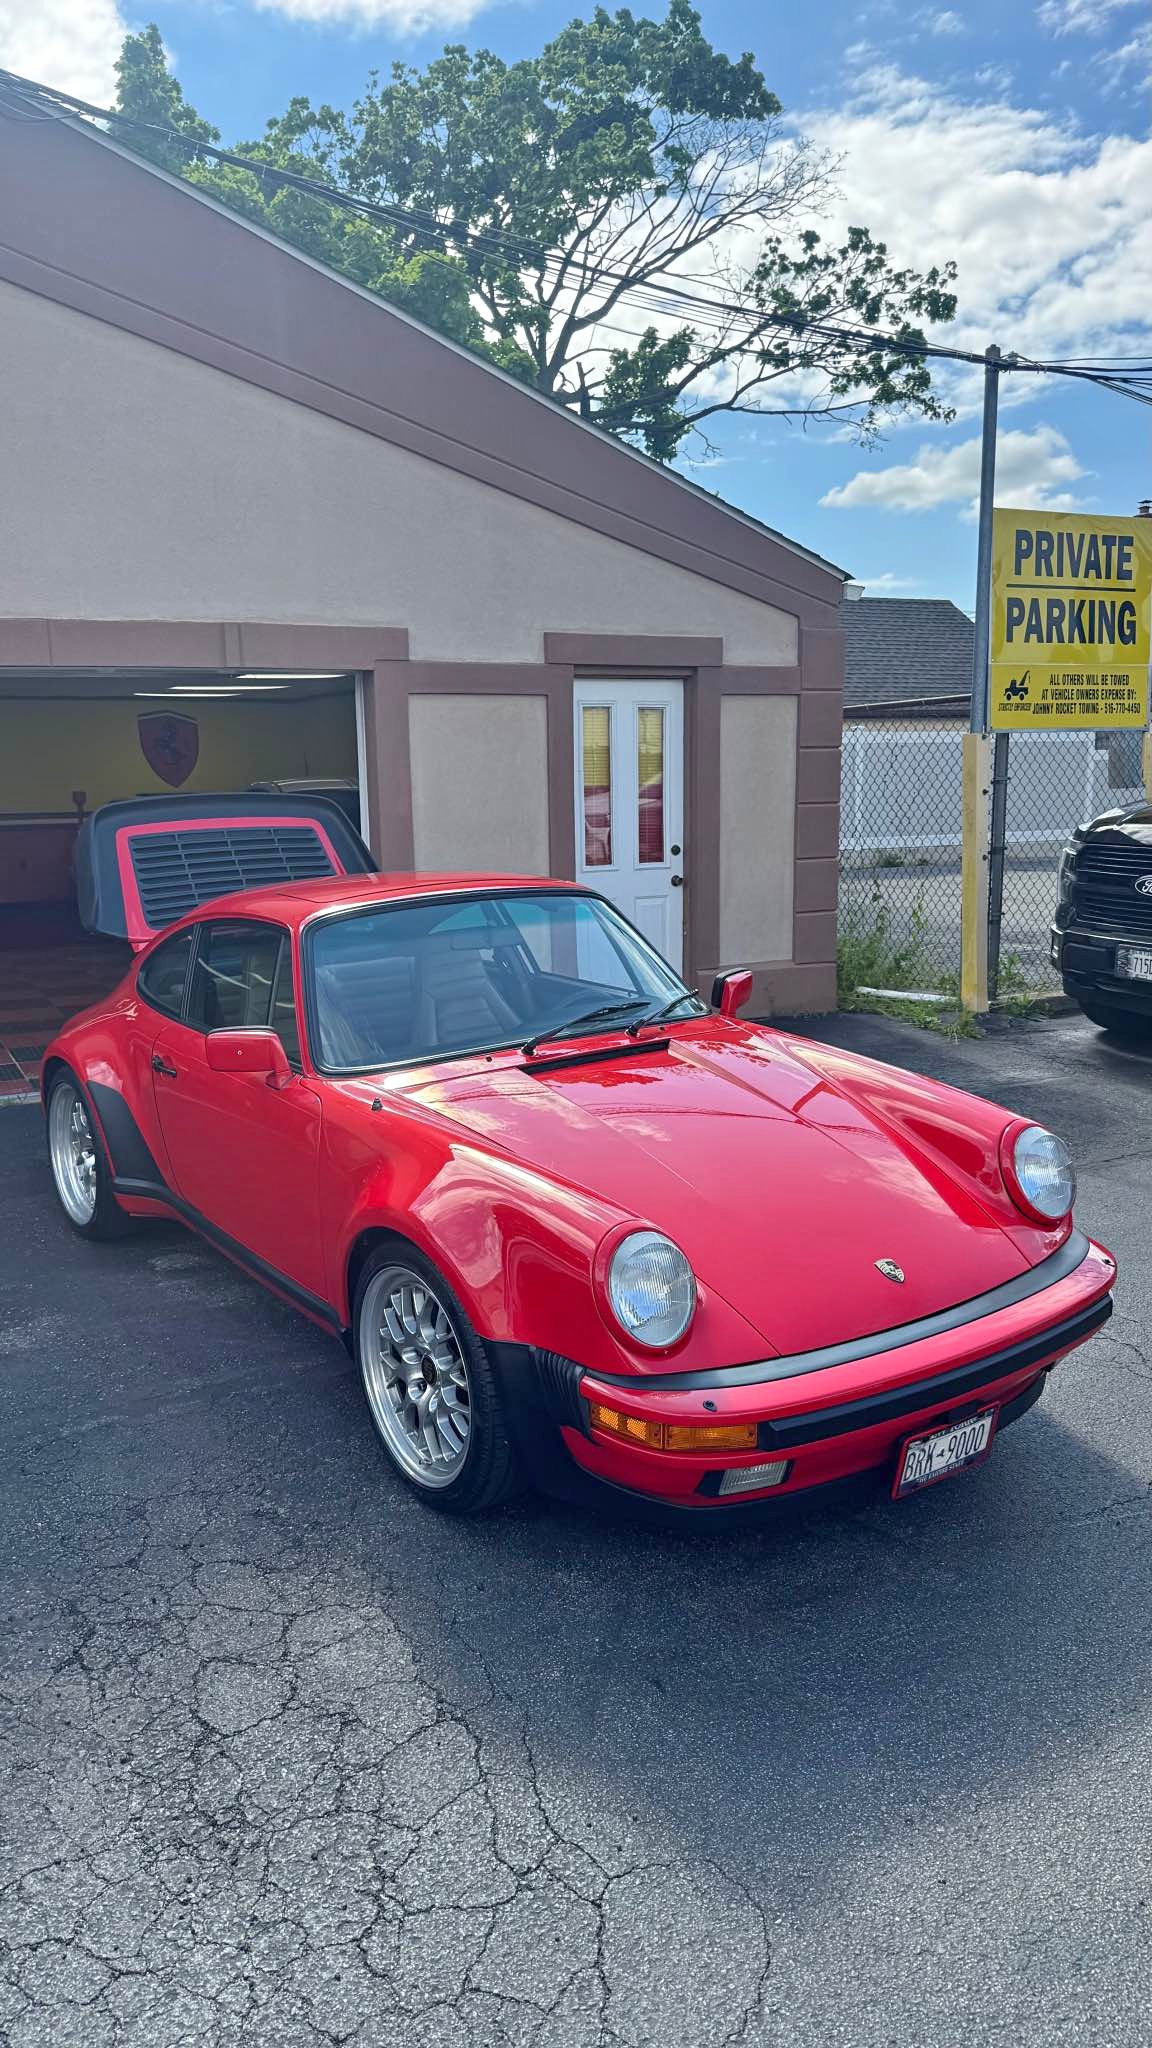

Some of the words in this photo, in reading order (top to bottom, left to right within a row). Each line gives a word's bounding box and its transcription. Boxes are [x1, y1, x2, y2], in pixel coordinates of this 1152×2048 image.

[1014, 529, 1134, 581] PRIVATE
[1006, 597, 1136, 645] PARKING
[1050, 673, 1060, 686] ALL
[1061, 673, 1084, 686] OTHERS
[1085, 674, 1099, 686] WILL
[1101, 674, 1109, 686] BE
[1110, 674, 1130, 686] TOWED
[1041, 688, 1049, 701] AT
[1050, 688, 1075, 701] VEHICLE
[1076, 688, 1100, 701] OWNERS
[1101, 689, 1125, 701] EXPENSE
[1127, 689, 1137, 701] BY:
[1032, 702, 1054, 715] JOHNNY
[1055, 702, 1077, 715] ROCKET
[1079, 702, 1100, 715] TOWING
